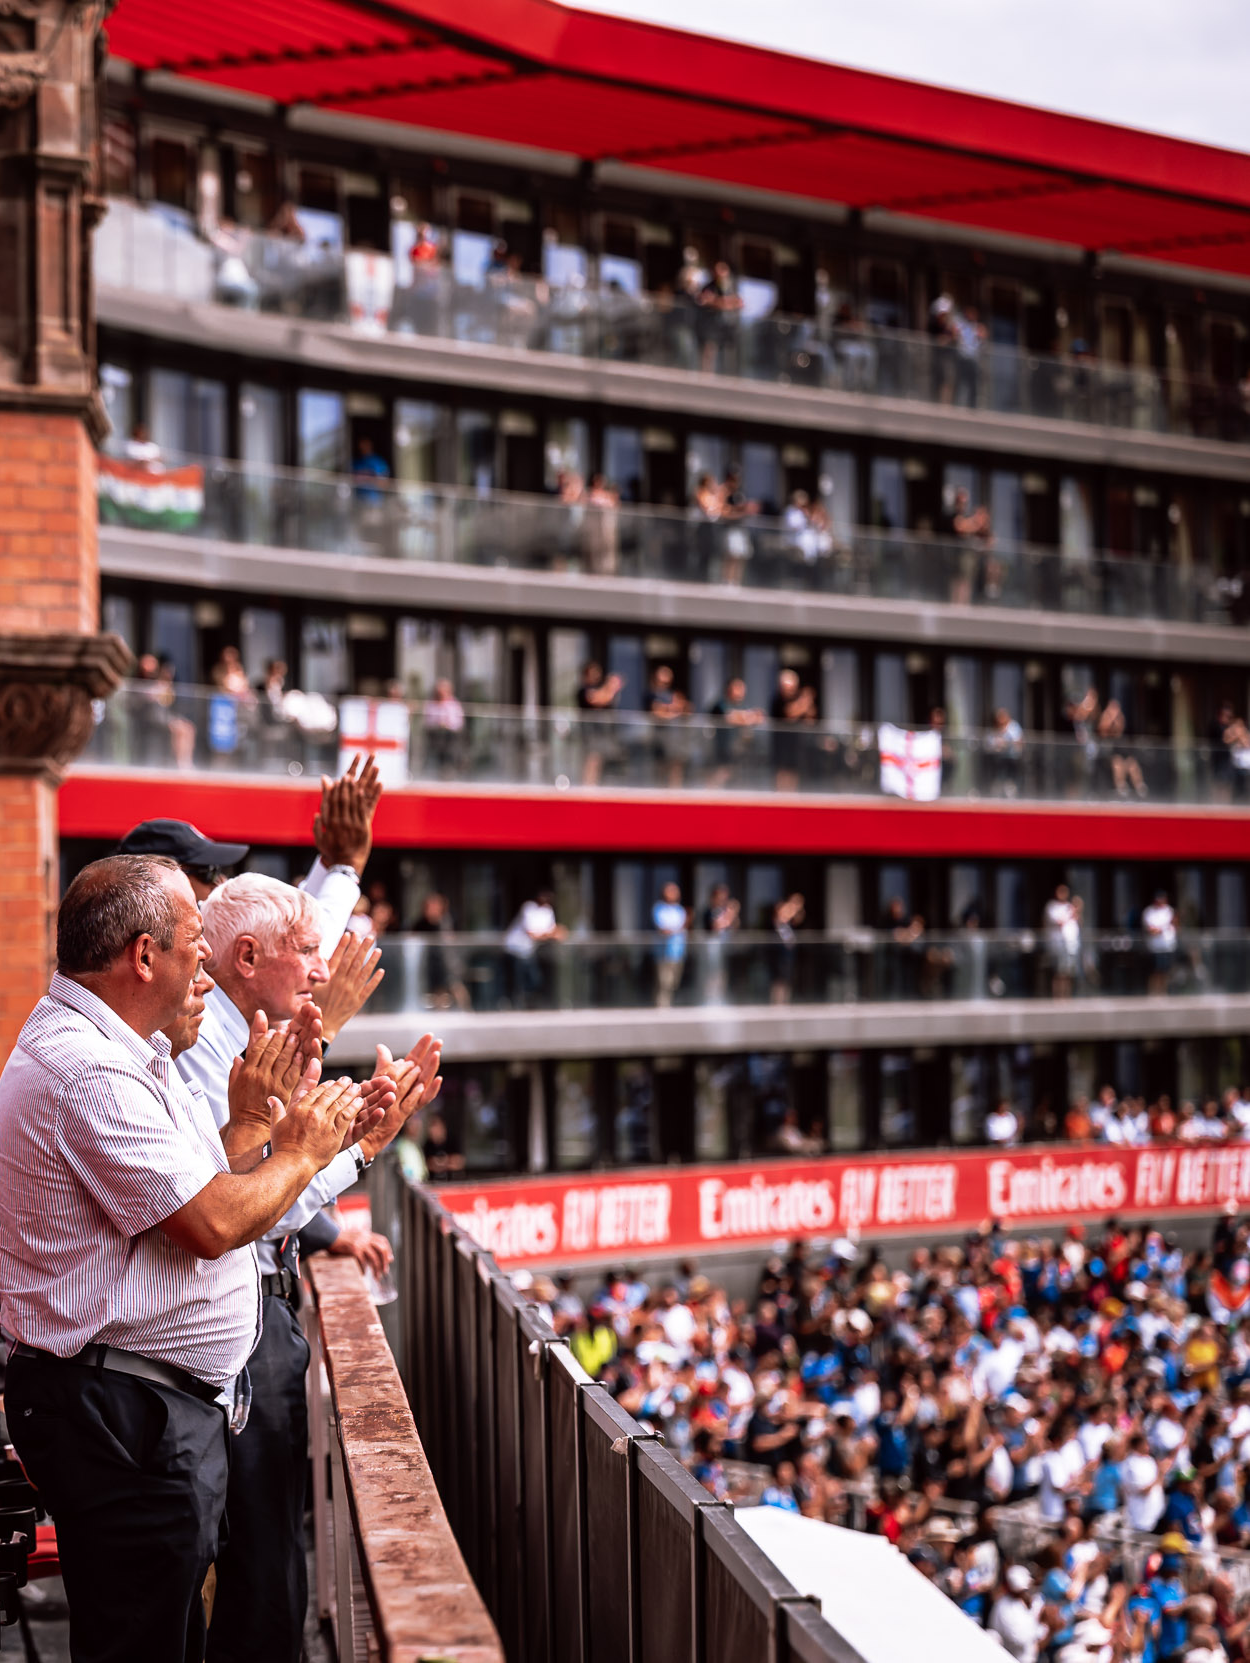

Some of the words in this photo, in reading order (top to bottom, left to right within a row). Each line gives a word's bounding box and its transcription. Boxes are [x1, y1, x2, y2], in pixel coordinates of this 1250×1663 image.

[699, 1175, 835, 1239] Emirates
[987, 1156, 1126, 1216] Emirates
[452, 1196, 556, 1258] irates
